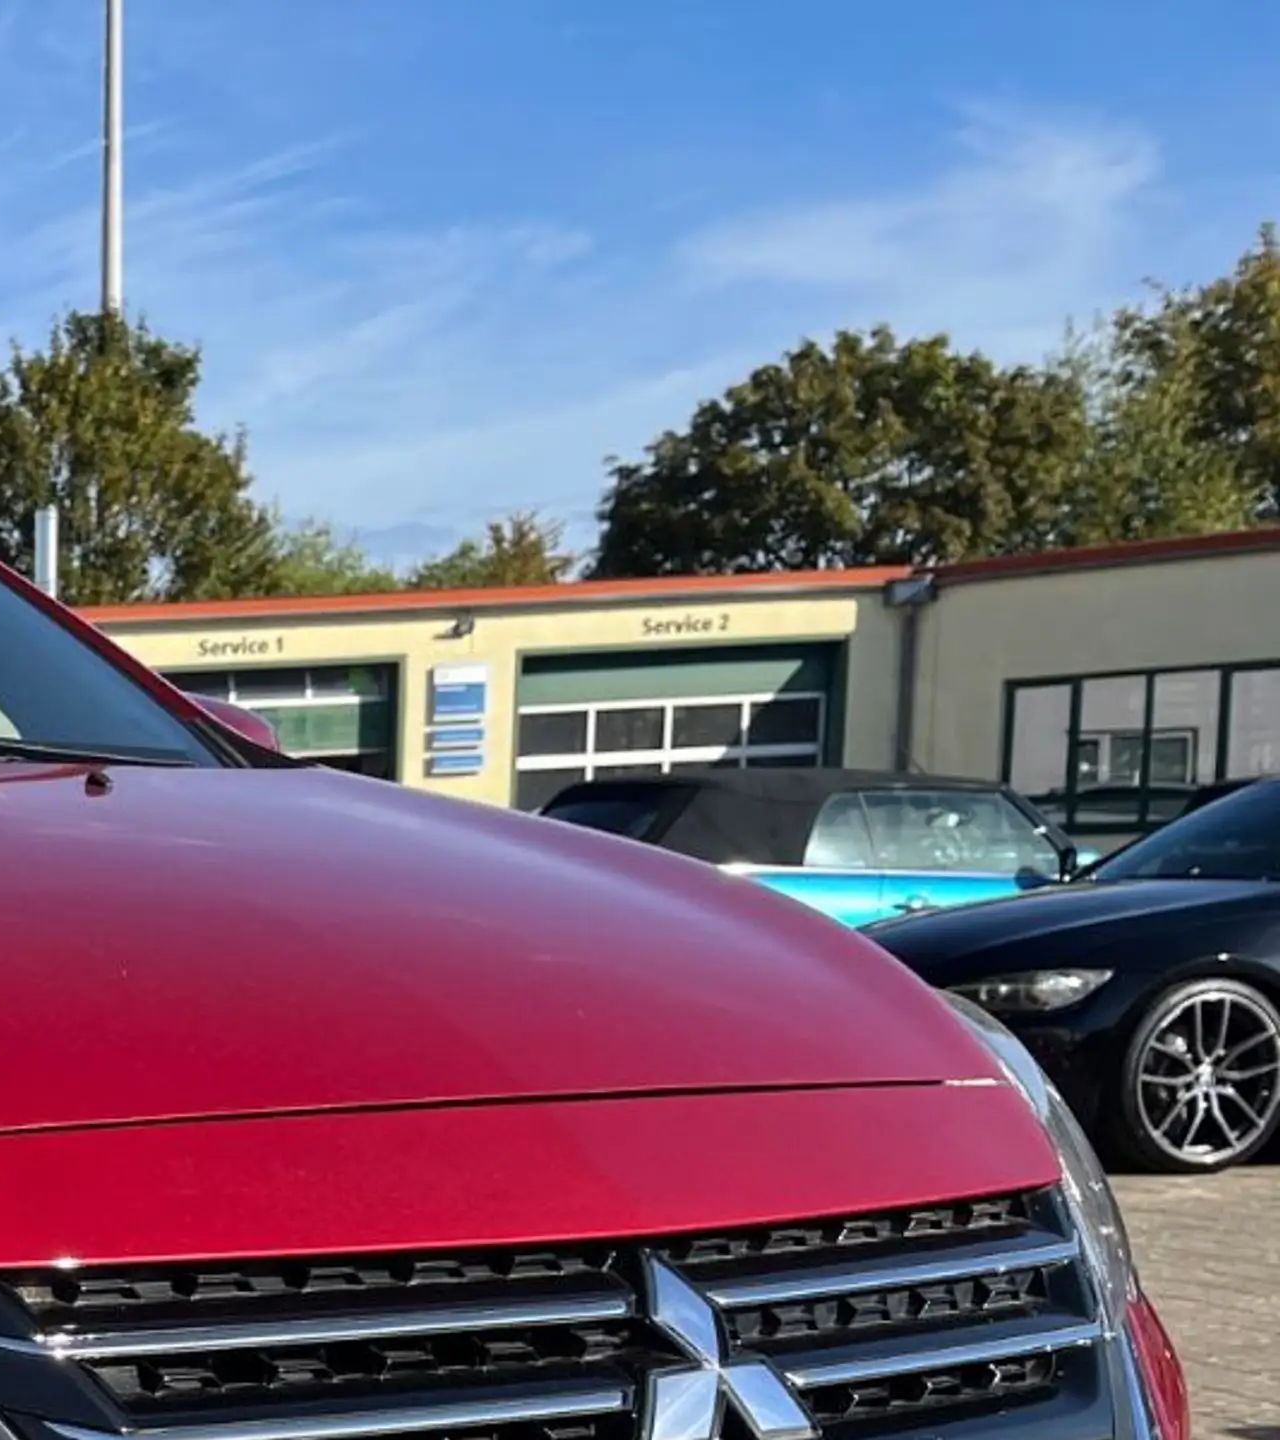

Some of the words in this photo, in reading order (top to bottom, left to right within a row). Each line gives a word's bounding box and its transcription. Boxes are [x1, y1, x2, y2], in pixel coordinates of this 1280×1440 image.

[642, 613, 713, 636] Service
[718, 613, 730, 631] 2
[197, 636, 269, 657] Service
[276, 636, 284, 653] 1
